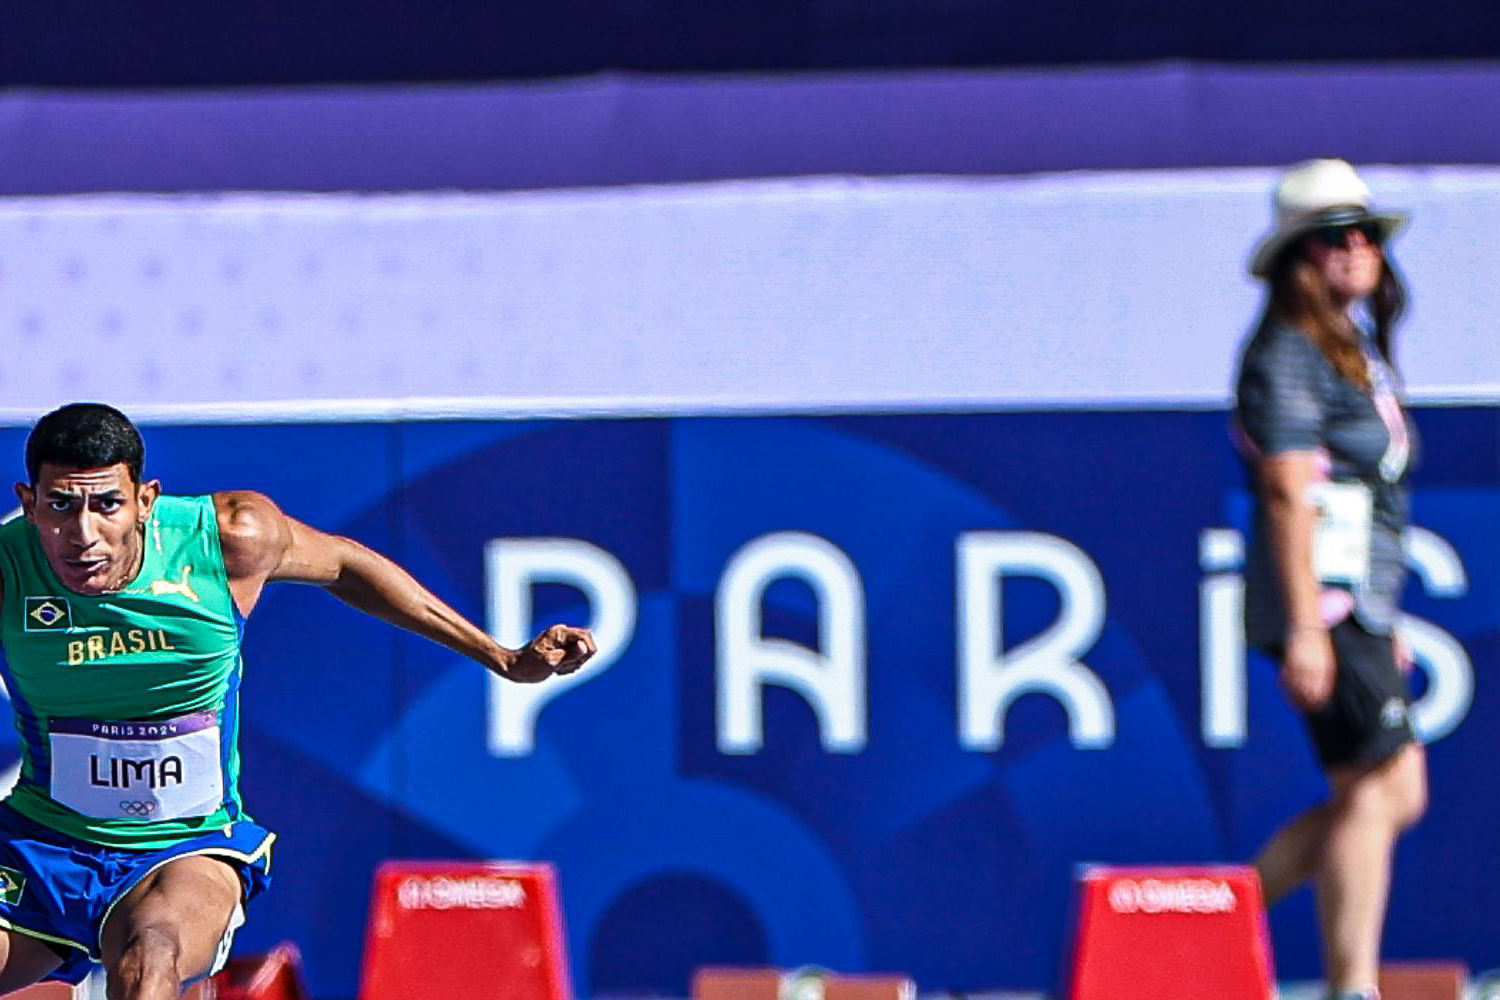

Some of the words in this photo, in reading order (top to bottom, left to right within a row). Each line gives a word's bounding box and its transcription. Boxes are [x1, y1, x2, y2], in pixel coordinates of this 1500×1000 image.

[68, 629, 175, 666] BRASIL
[138, 723, 178, 736] 2024
[90, 754, 183, 790] LIMA
